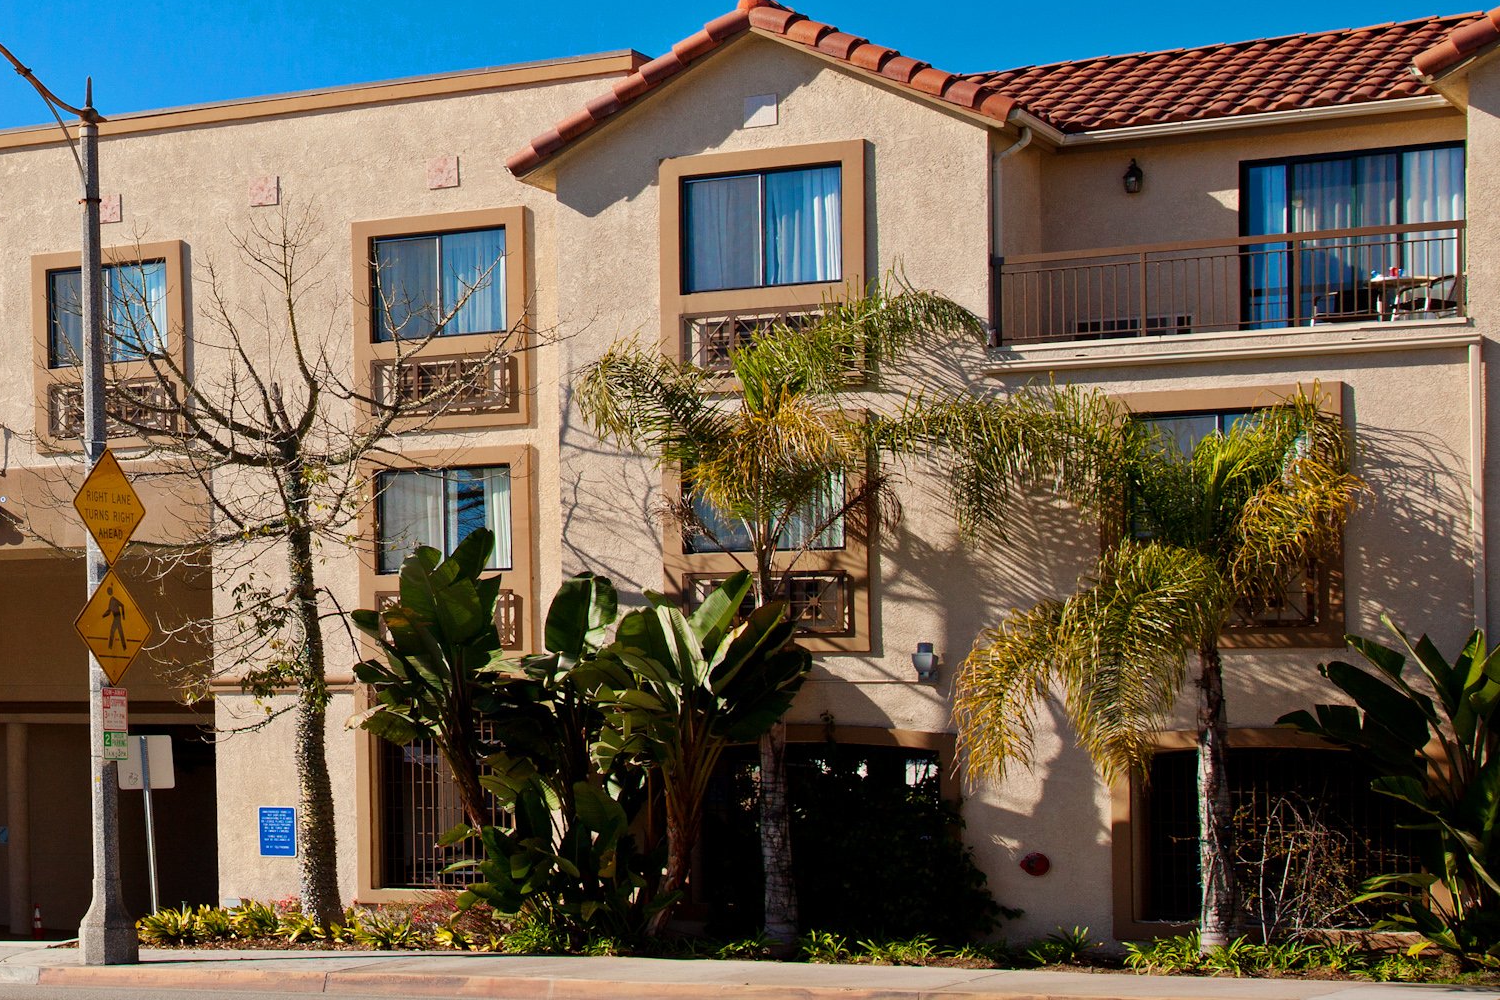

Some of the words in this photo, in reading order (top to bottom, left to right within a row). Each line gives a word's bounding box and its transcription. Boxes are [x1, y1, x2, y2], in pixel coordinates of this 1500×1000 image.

[86, 490, 108, 503] RIGHT
[112, 493, 131, 506] LANE
[84, 508, 109, 521] TURNS
[113, 511, 135, 523] RIGHT
[98, 527, 123, 540] AHEAD
[105, 734, 111, 745] 2
